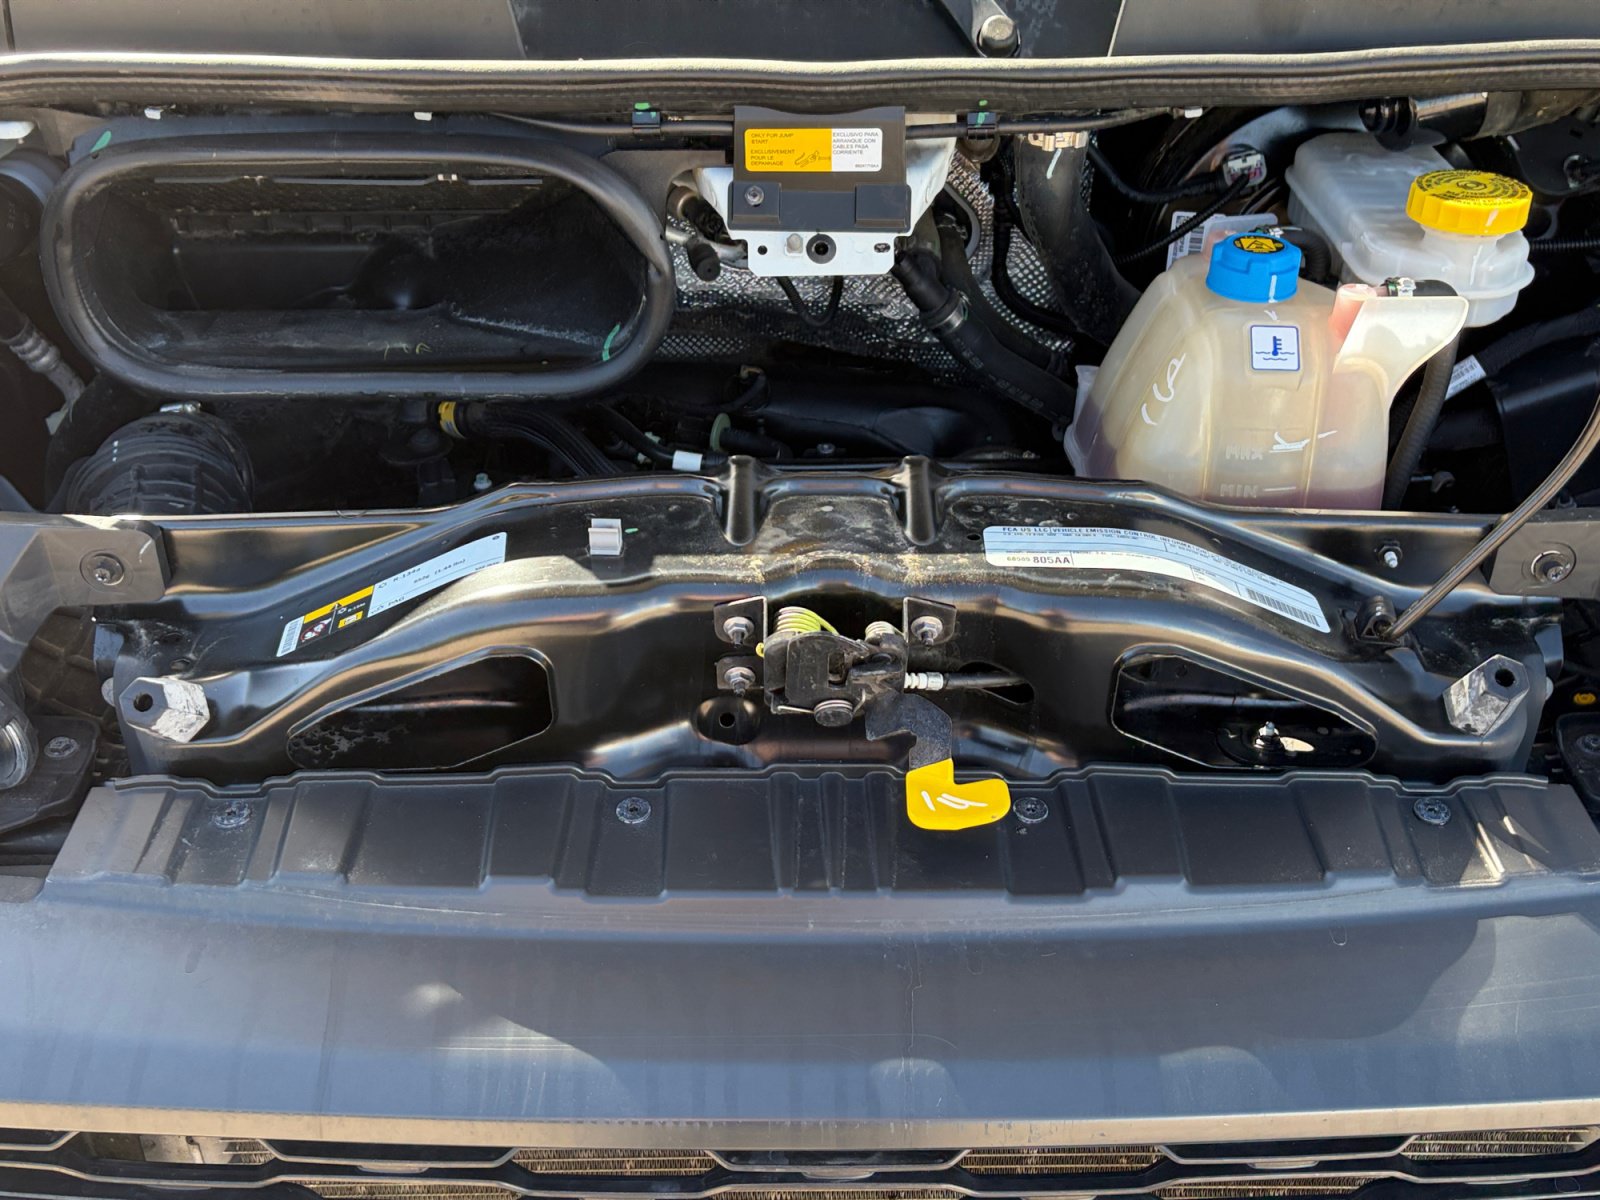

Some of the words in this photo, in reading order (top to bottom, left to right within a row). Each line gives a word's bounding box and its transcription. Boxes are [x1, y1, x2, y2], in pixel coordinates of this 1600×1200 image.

[1220, 484, 1259, 498] MIN
[1123, 530, 1157, 540] CONTROL
[1033, 556, 1071, 564] 805AA
